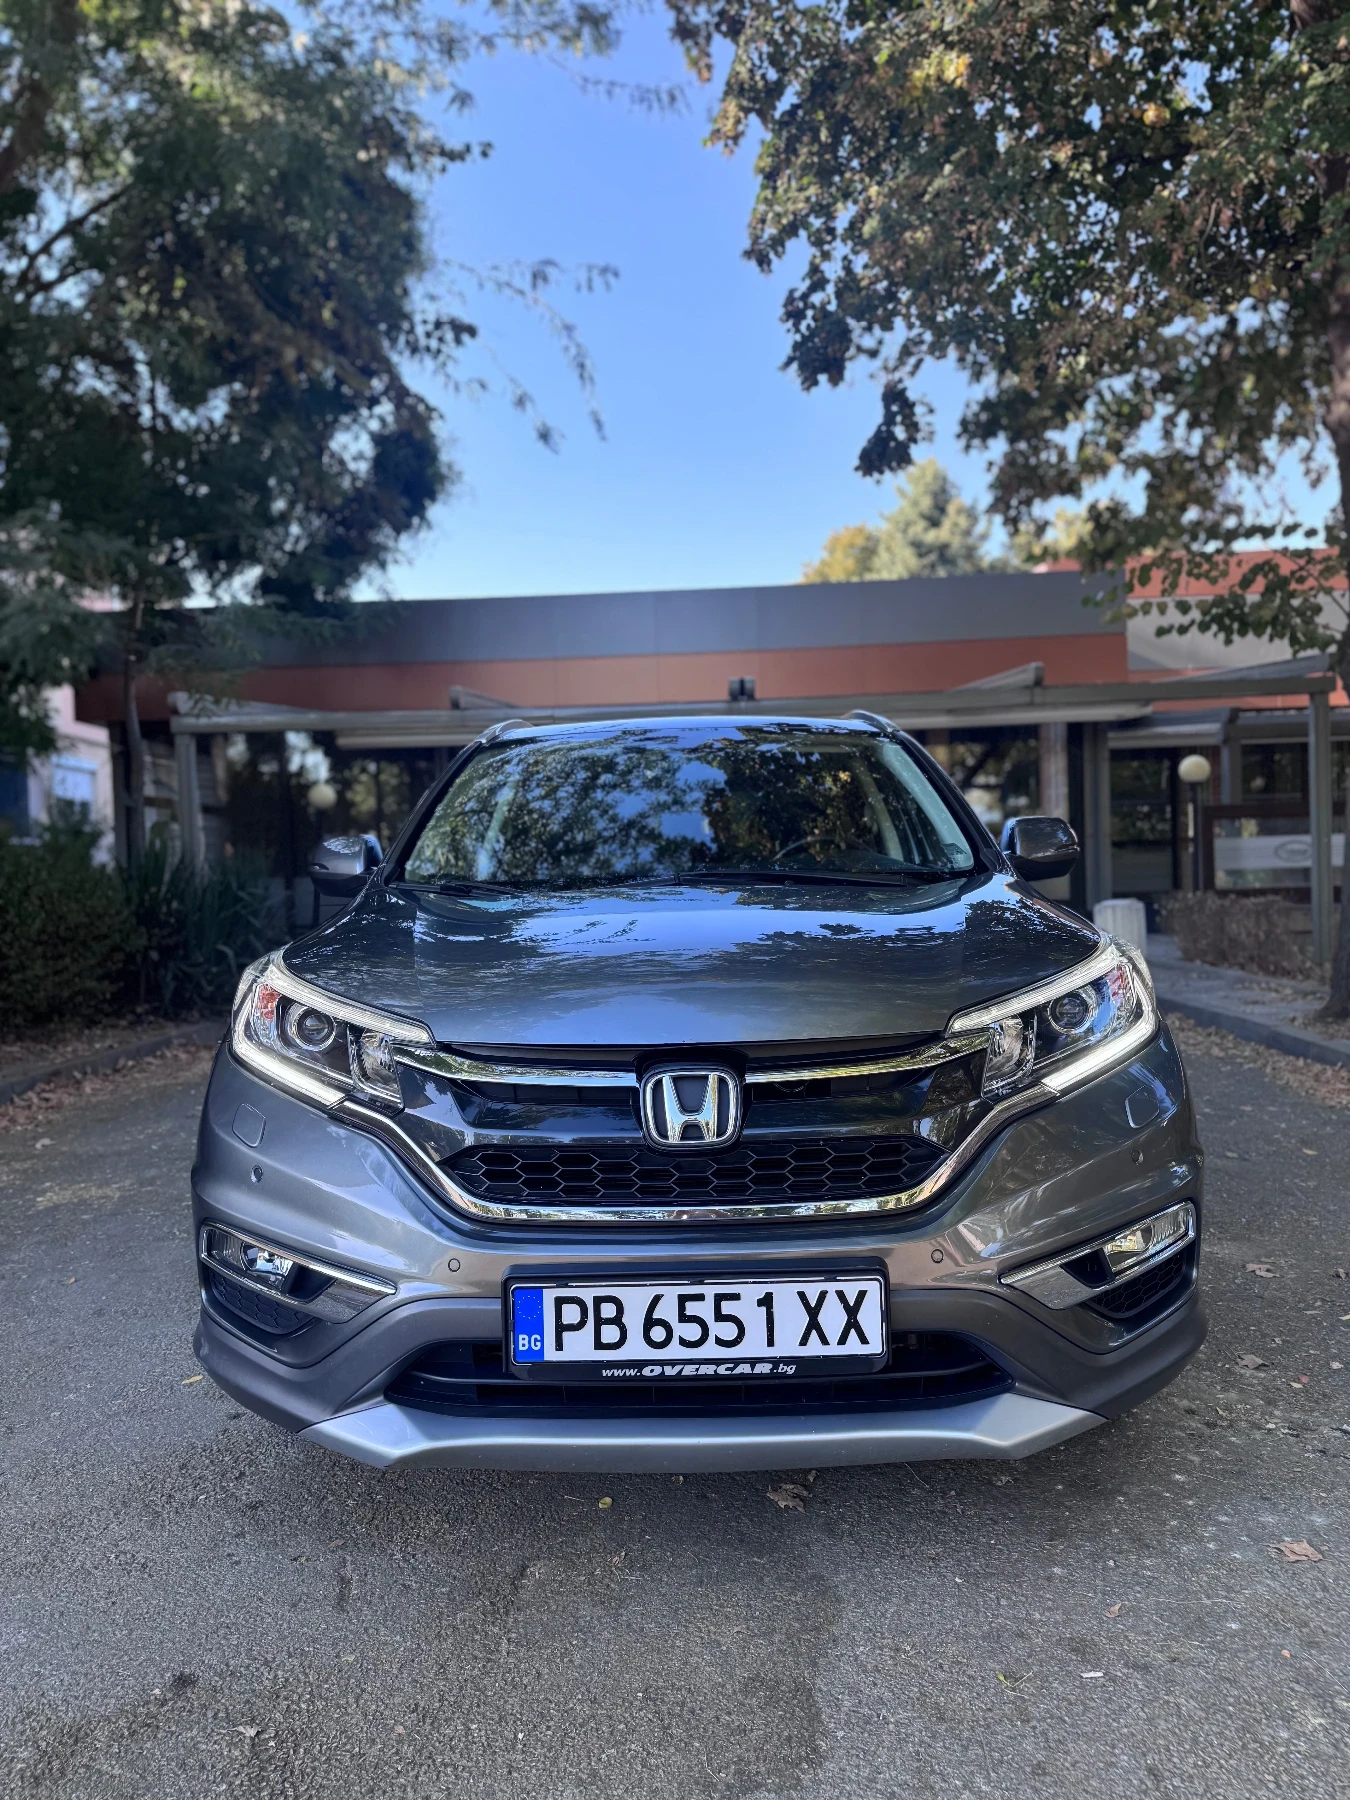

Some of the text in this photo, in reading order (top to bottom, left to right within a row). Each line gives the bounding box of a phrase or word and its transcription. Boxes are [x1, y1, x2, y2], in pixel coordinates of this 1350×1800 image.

[553, 1289, 871, 1352] PB 6551 XX
[518, 1334, 542, 1351] BG
[602, 1362, 797, 1377] www.OVERCAR.bg
